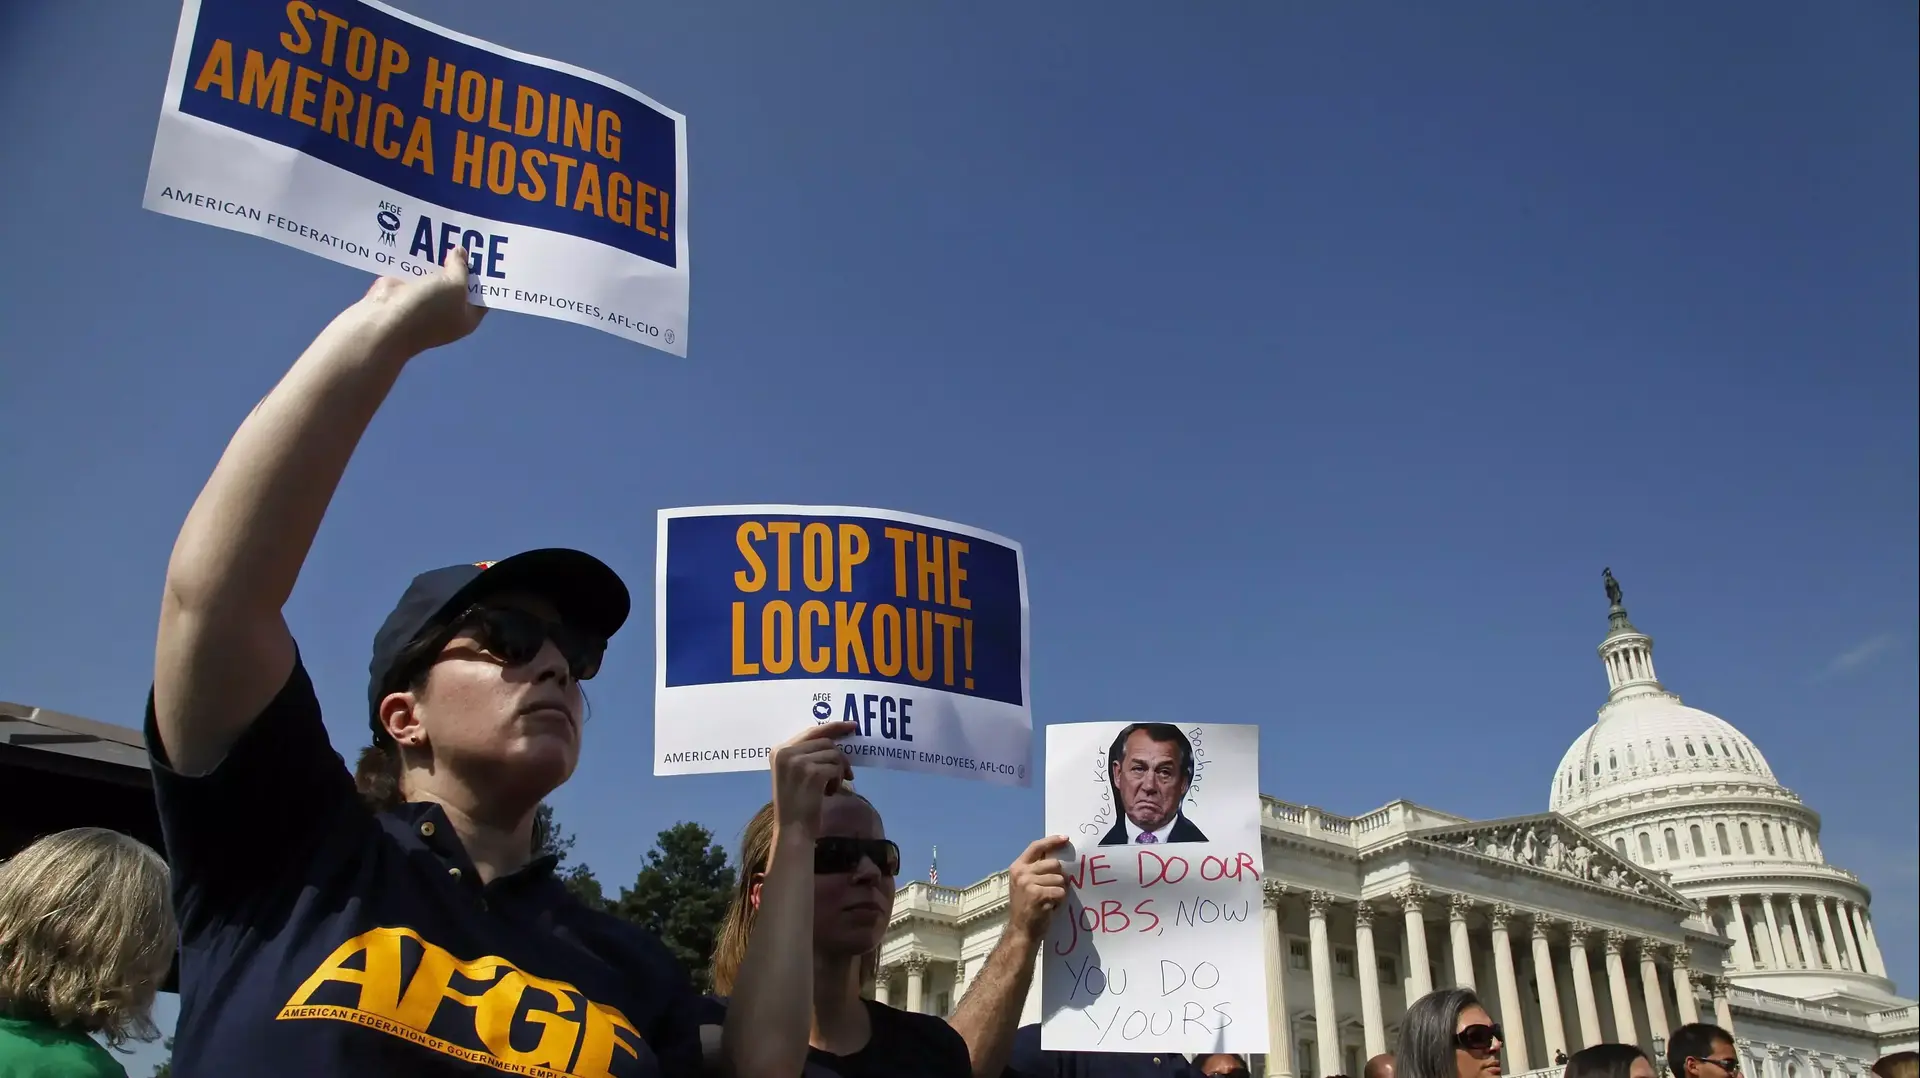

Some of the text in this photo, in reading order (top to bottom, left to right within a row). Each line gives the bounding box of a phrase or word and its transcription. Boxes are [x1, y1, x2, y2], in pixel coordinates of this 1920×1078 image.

[280, 0, 622, 162] STOP HOLDING
[194, 38, 670, 241] AMERICA HOSTAGE!
[378, 200, 402, 216] AFGE
[161, 187, 262, 221] AMERICAN
[267, 213, 370, 259] FEDERATION
[375, 252, 396, 266] OF
[400, 261, 510, 298] GOMENT
[515, 289, 604, 321] EMPLOYEES,
[608, 312, 659, 338] AFL-CIO
[409, 215, 509, 279] AFGE
[734, 521, 971, 610] STOP THE
[732, 600, 975, 690] LOCKOUT!
[812, 693, 832, 702] AFGE
[843, 693, 913, 742] AFGE
[664, 750, 729, 764] AMERICAN
[919, 751, 979, 772] EMPLOYEES,
[980, 761, 1015, 776] AFL-CIO
[1188, 727, 1212, 807] Boehner
[1138, 850, 1189, 888] DO
[1200, 852, 1260, 882] OUR
[1055, 896, 1249, 956] JOBS, NOW
[286, 927, 642, 1078] AFGE
[1065, 955, 1220, 1000] YOU DO
[282, 1007, 347, 1018] AMERICAN
[351, 1012, 426, 1044] FEDERATION
[428, 1039, 444, 1049] OF
[447, 1045, 526, 1073] GOVERNMENT
[1083, 1001, 1233, 1045] YOURS
